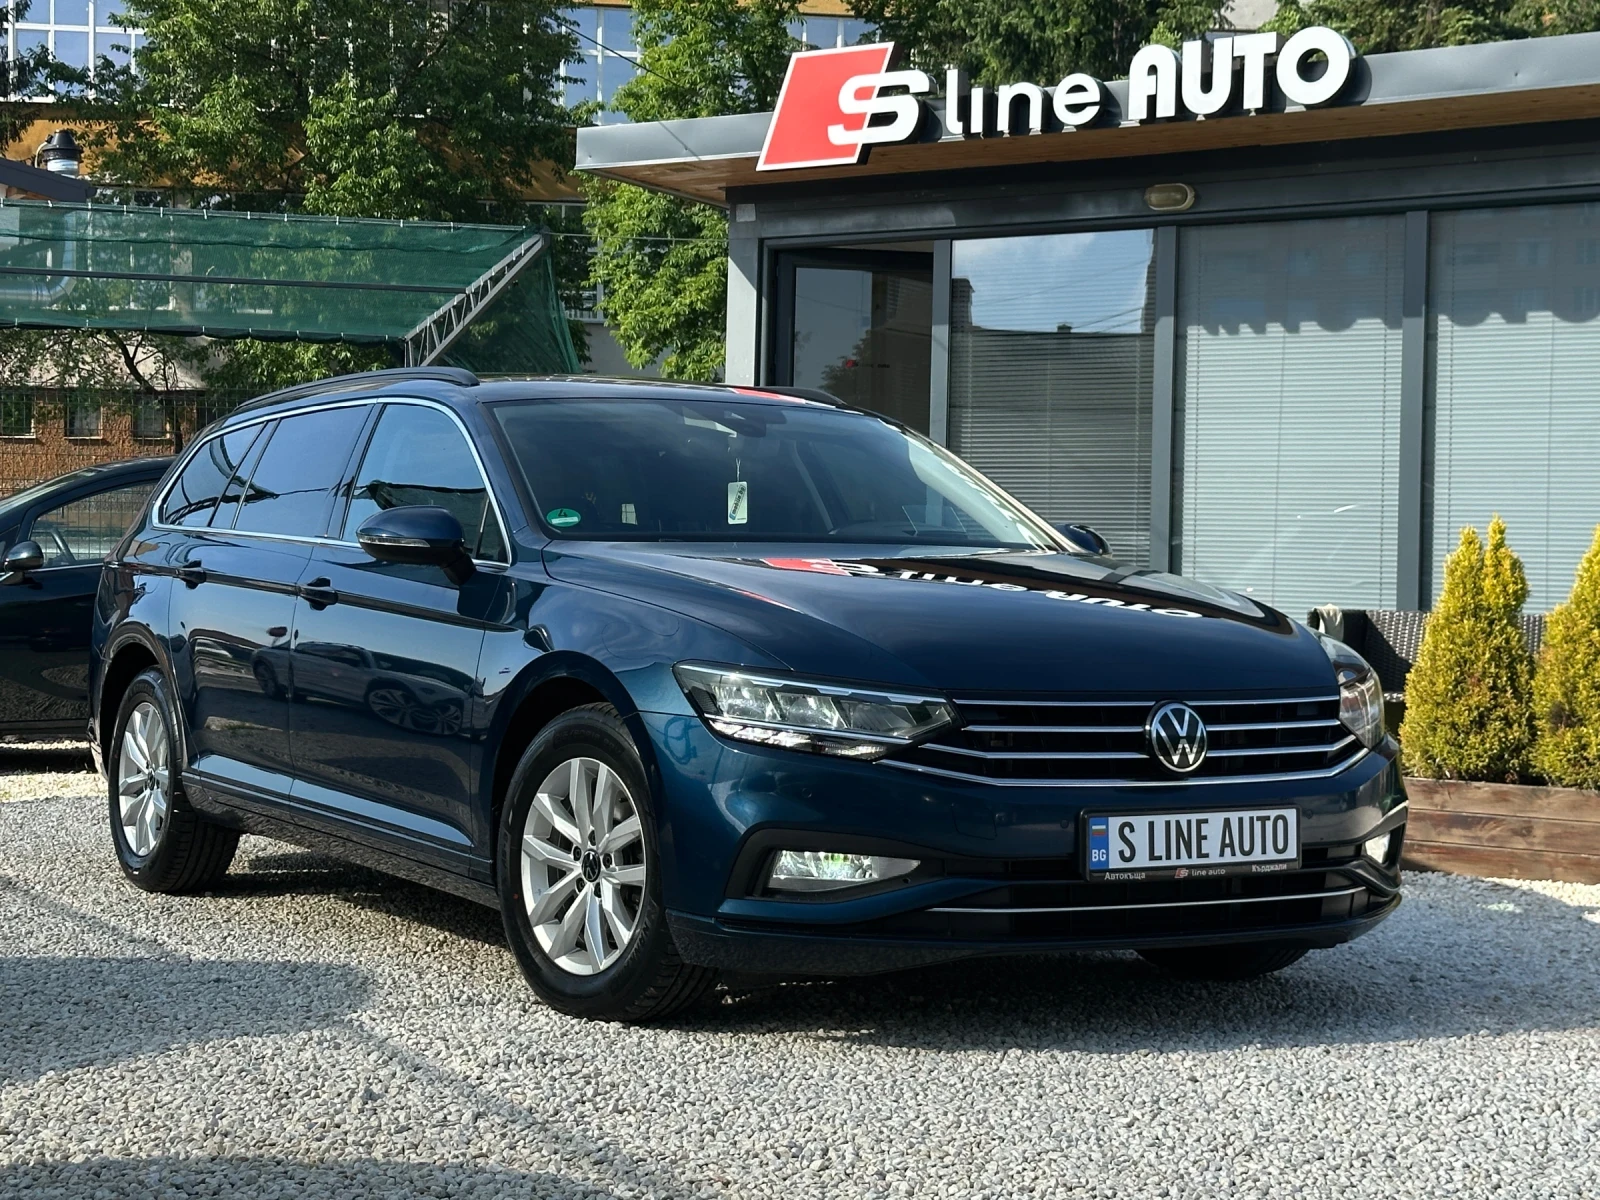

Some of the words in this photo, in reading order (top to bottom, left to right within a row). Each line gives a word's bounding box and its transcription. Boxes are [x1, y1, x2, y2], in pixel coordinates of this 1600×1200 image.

[827, 69, 930, 146] S
[945, 68, 1101, 134] line
[1127, 26, 1351, 121] AUTO
[558, 509, 568, 518] 4
[1153, 704, 1205, 770] VW
[1117, 820, 1137, 863] S
[1147, 817, 1210, 862] LINE
[1218, 813, 1289, 858] AUTO
[1091, 849, 1107, 862] BG
[1191, 869, 1207, 877] line
[1207, 868, 1226, 876] auto
[1251, 863, 1288, 873] Кърджали
[1104, 871, 1146, 881] Автокъща
